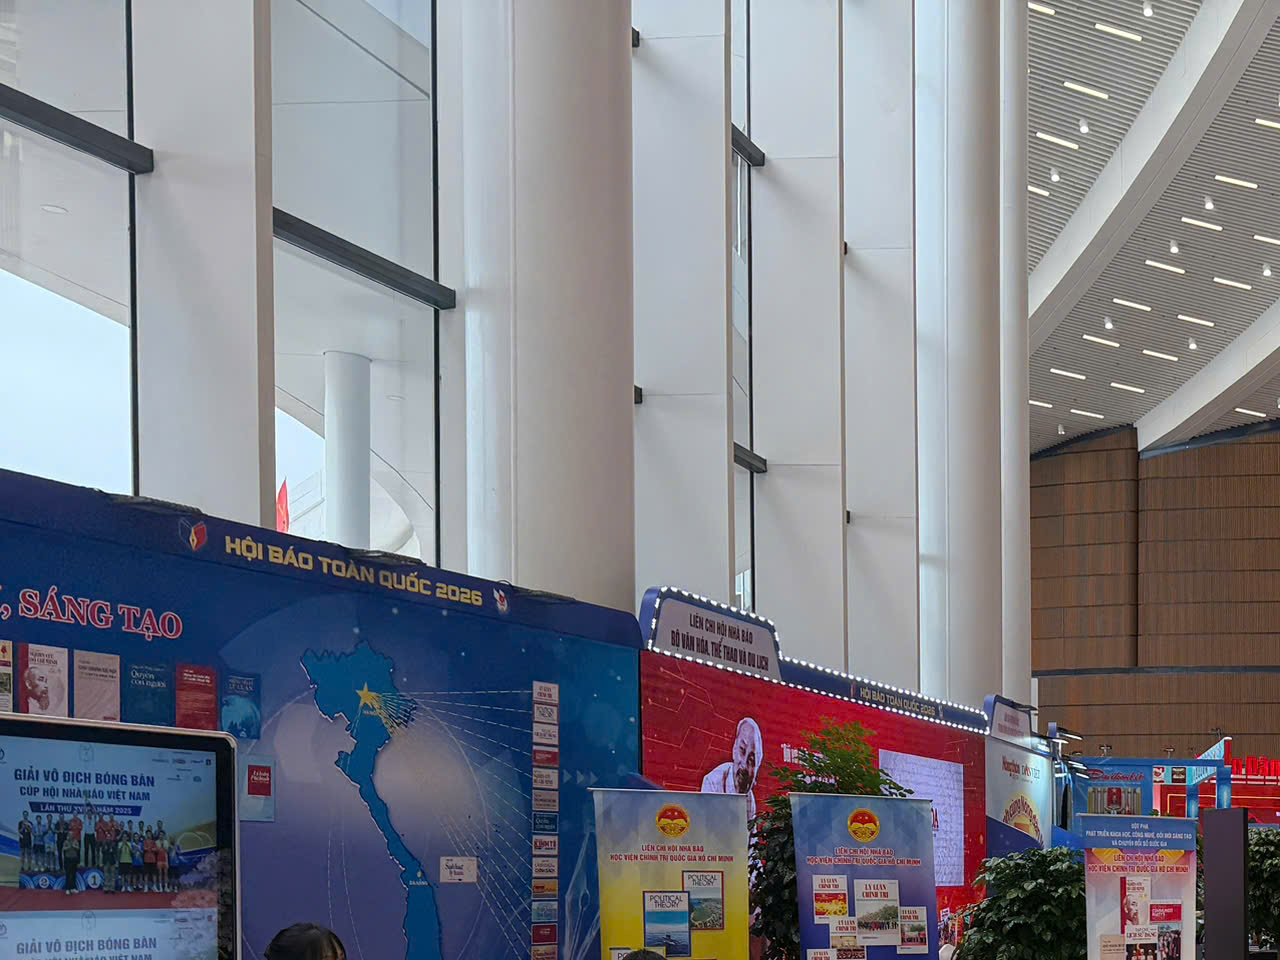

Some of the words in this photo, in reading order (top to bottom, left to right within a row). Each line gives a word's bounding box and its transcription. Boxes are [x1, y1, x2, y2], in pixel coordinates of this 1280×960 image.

[224, 535, 263, 562] HỘI
[267, 545, 314, 570] BÁO
[318, 555, 374, 584] TOÀN
[379, 570, 432, 596] QUỐC
[435, 582, 483, 606] 2026
[19, 585, 113, 629] SÁNG
[118, 604, 183, 641] TẠO
[689, 613, 704, 630] LIÊN
[704, 618, 716, 633] CHI
[716, 620, 727, 637] HỘI
[728, 623, 740, 640] NHÀ
[741, 627, 753, 644] BÁO
[671, 629, 681, 651] BỘ
[681, 631, 695, 651] VĂN
[711, 636, 723, 659] THỂ
[723, 645, 738, 663] THAO
[739, 647, 747, 666] VÀ
[748, 652, 756, 668] DU
[756, 656, 769, 673] LỊCH
[860, 686, 872, 701] HỘI
[871, 689, 885, 703] BÁO
[886, 693, 903, 707] TOÀN
[903, 698, 919, 712] QUỐC
[920, 703, 936, 716] 2026
[14, 765, 39, 781] GIẢI
[43, 768, 59, 783] VÔ
[62, 771, 92, 786] ĐỊCH
[95, 771, 128, 786] BÓNG
[131, 773, 155, 787] BÀN
[19, 785, 40, 798] CÚP
[42, 786, 59, 799] HỘI
[62, 786, 83, 799] NHÀ
[107, 789, 127, 802] VIỆT
[128, 790, 151, 801] NAM
[610, 854, 623, 862] HỌC
[639, 853, 659, 862] CHÍNH
[659, 854, 669, 863] TRỊ
[669, 853, 686, 862] QUỐC
[687, 854, 697, 862] GIA
[641, 844, 655, 852] LIÊN
[667, 844, 678, 853] HỘI
[650, 894, 683, 902] POLITICAL
[654, 901, 680, 909] THEORY
[16, 938, 42, 955] GIẢI
[45, 939, 61, 953] VÔ
[65, 941, 94, 953] ĐỊCH
[97, 937, 130, 950] BÓNG
[133, 936, 157, 950] BÀN
